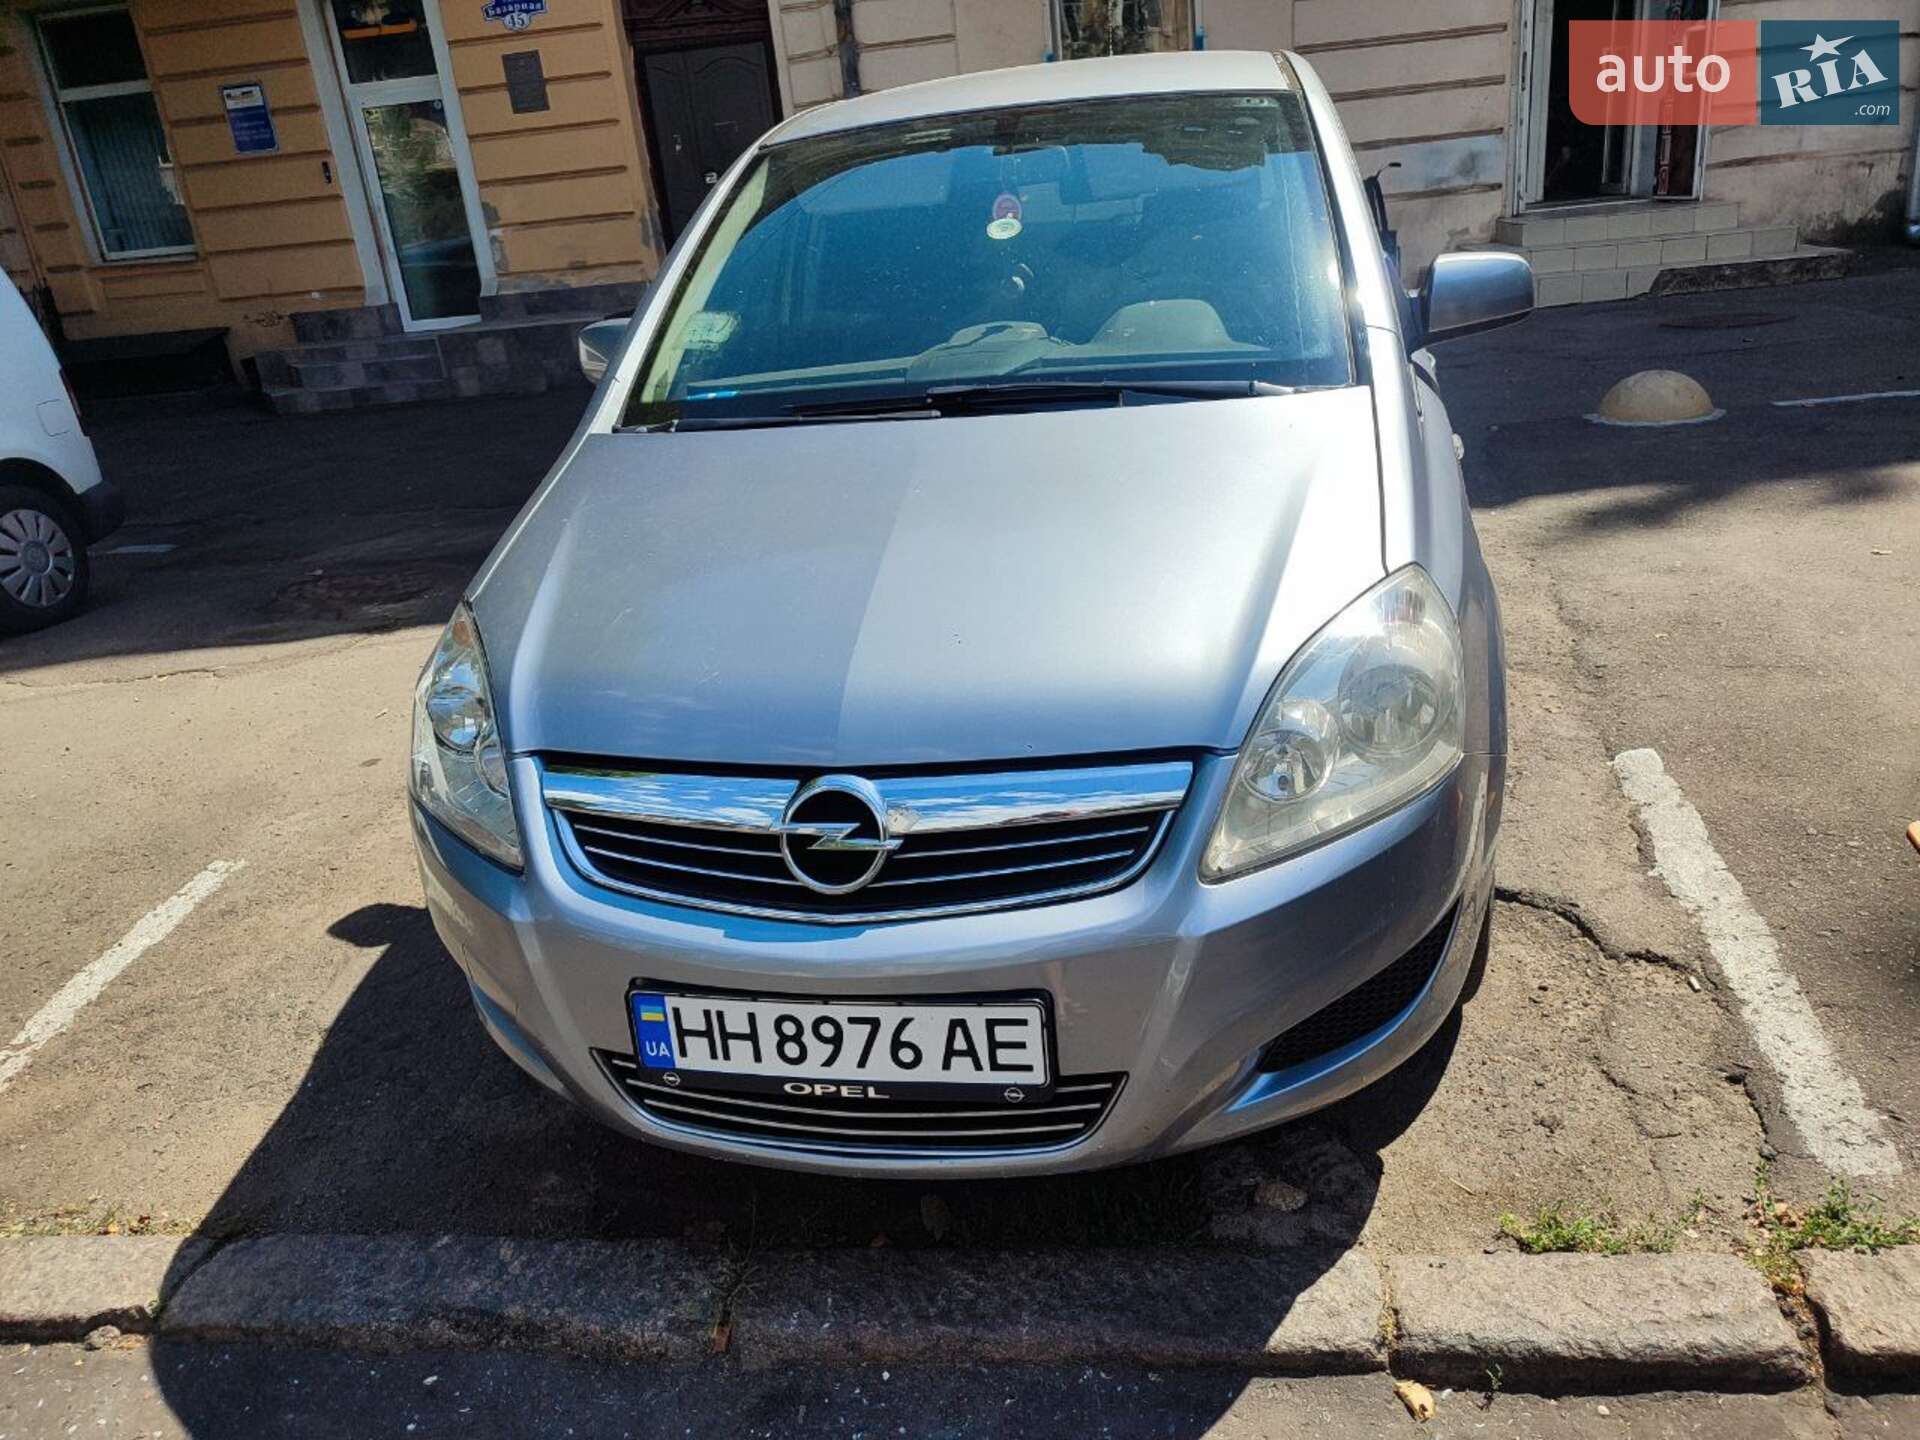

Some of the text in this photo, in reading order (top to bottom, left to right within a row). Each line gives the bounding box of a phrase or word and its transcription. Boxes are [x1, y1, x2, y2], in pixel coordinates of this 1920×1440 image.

[507, 13, 526, 27] 45
[672, 1007, 1034, 1072] HH 8976 AE
[645, 1041, 671, 1058] UA
[783, 1082, 890, 1099] OPEL
